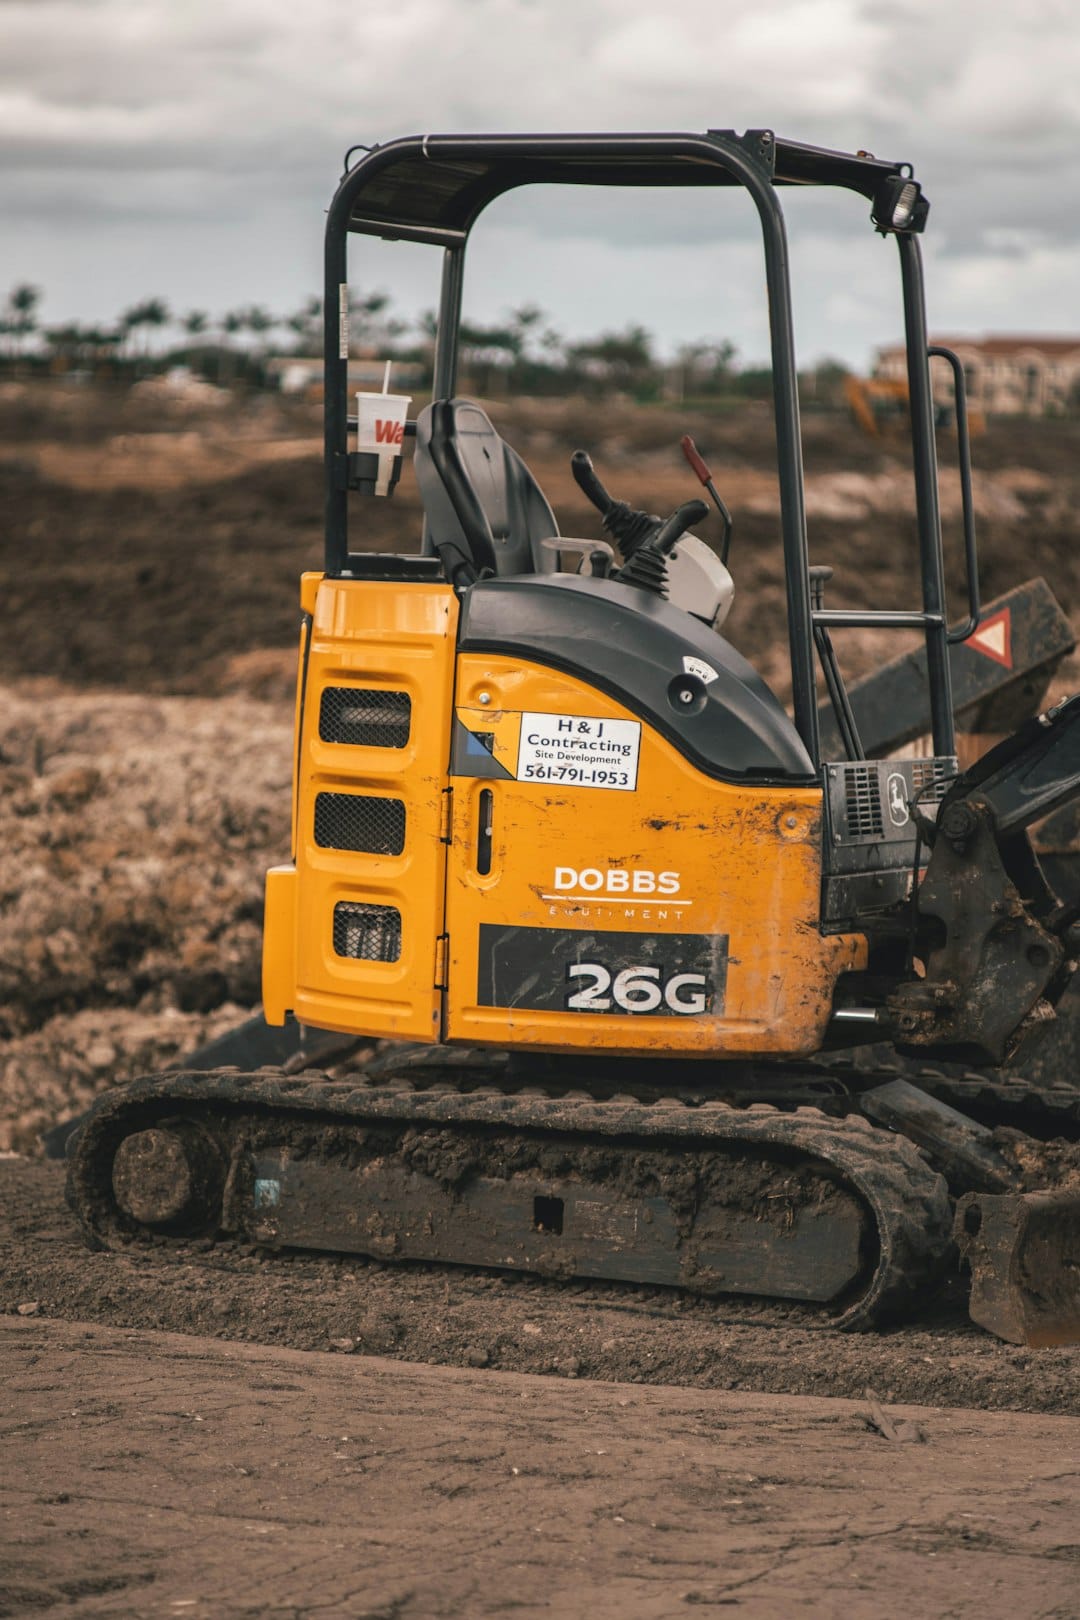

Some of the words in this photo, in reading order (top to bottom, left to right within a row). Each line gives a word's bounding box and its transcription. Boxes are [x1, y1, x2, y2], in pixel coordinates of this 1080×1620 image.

[558, 719, 572, 732] H
[577, 721, 591, 734] &
[597, 722, 604, 738] J
[527, 734, 632, 757] Contracting
[535, 749, 554, 759] Site
[557, 751, 622, 765] Development
[524, 764, 629, 786] 561-791-1953
[554, 866, 681, 894] DOBBS
[567, 963, 706, 1014] 26G
